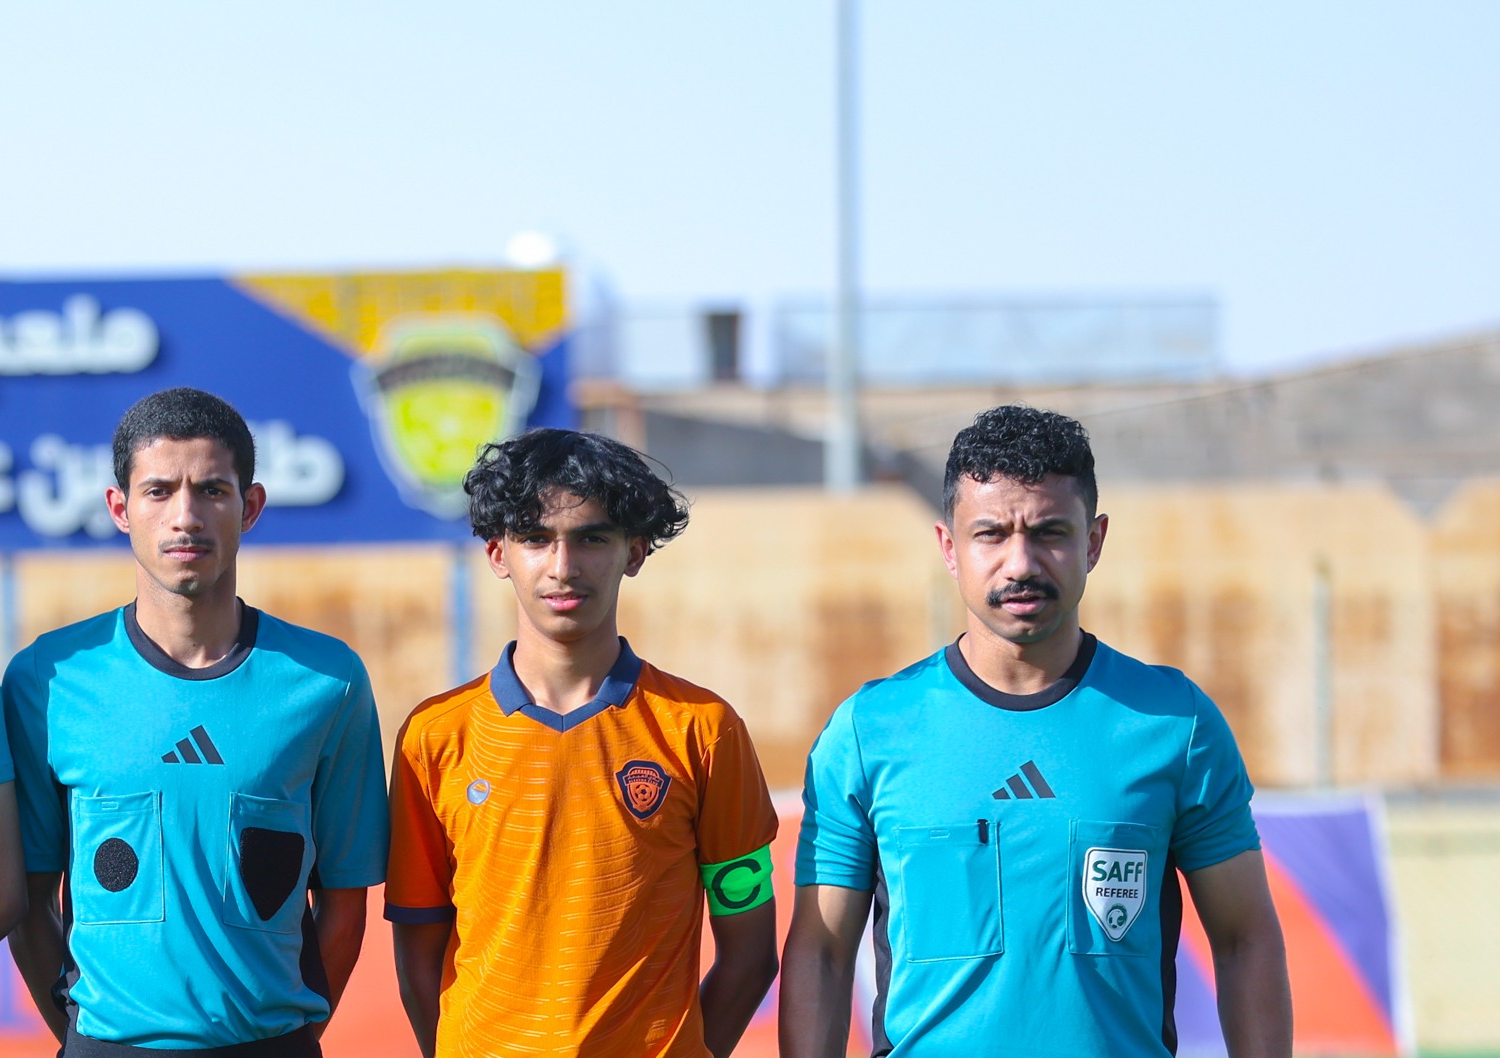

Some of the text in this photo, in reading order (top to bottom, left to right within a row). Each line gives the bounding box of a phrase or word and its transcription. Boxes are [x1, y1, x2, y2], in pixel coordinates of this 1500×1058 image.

[1091, 859, 1144, 882] SAFF
[711, 858, 762, 909] C
[1095, 887, 1138, 899] REFEREE
